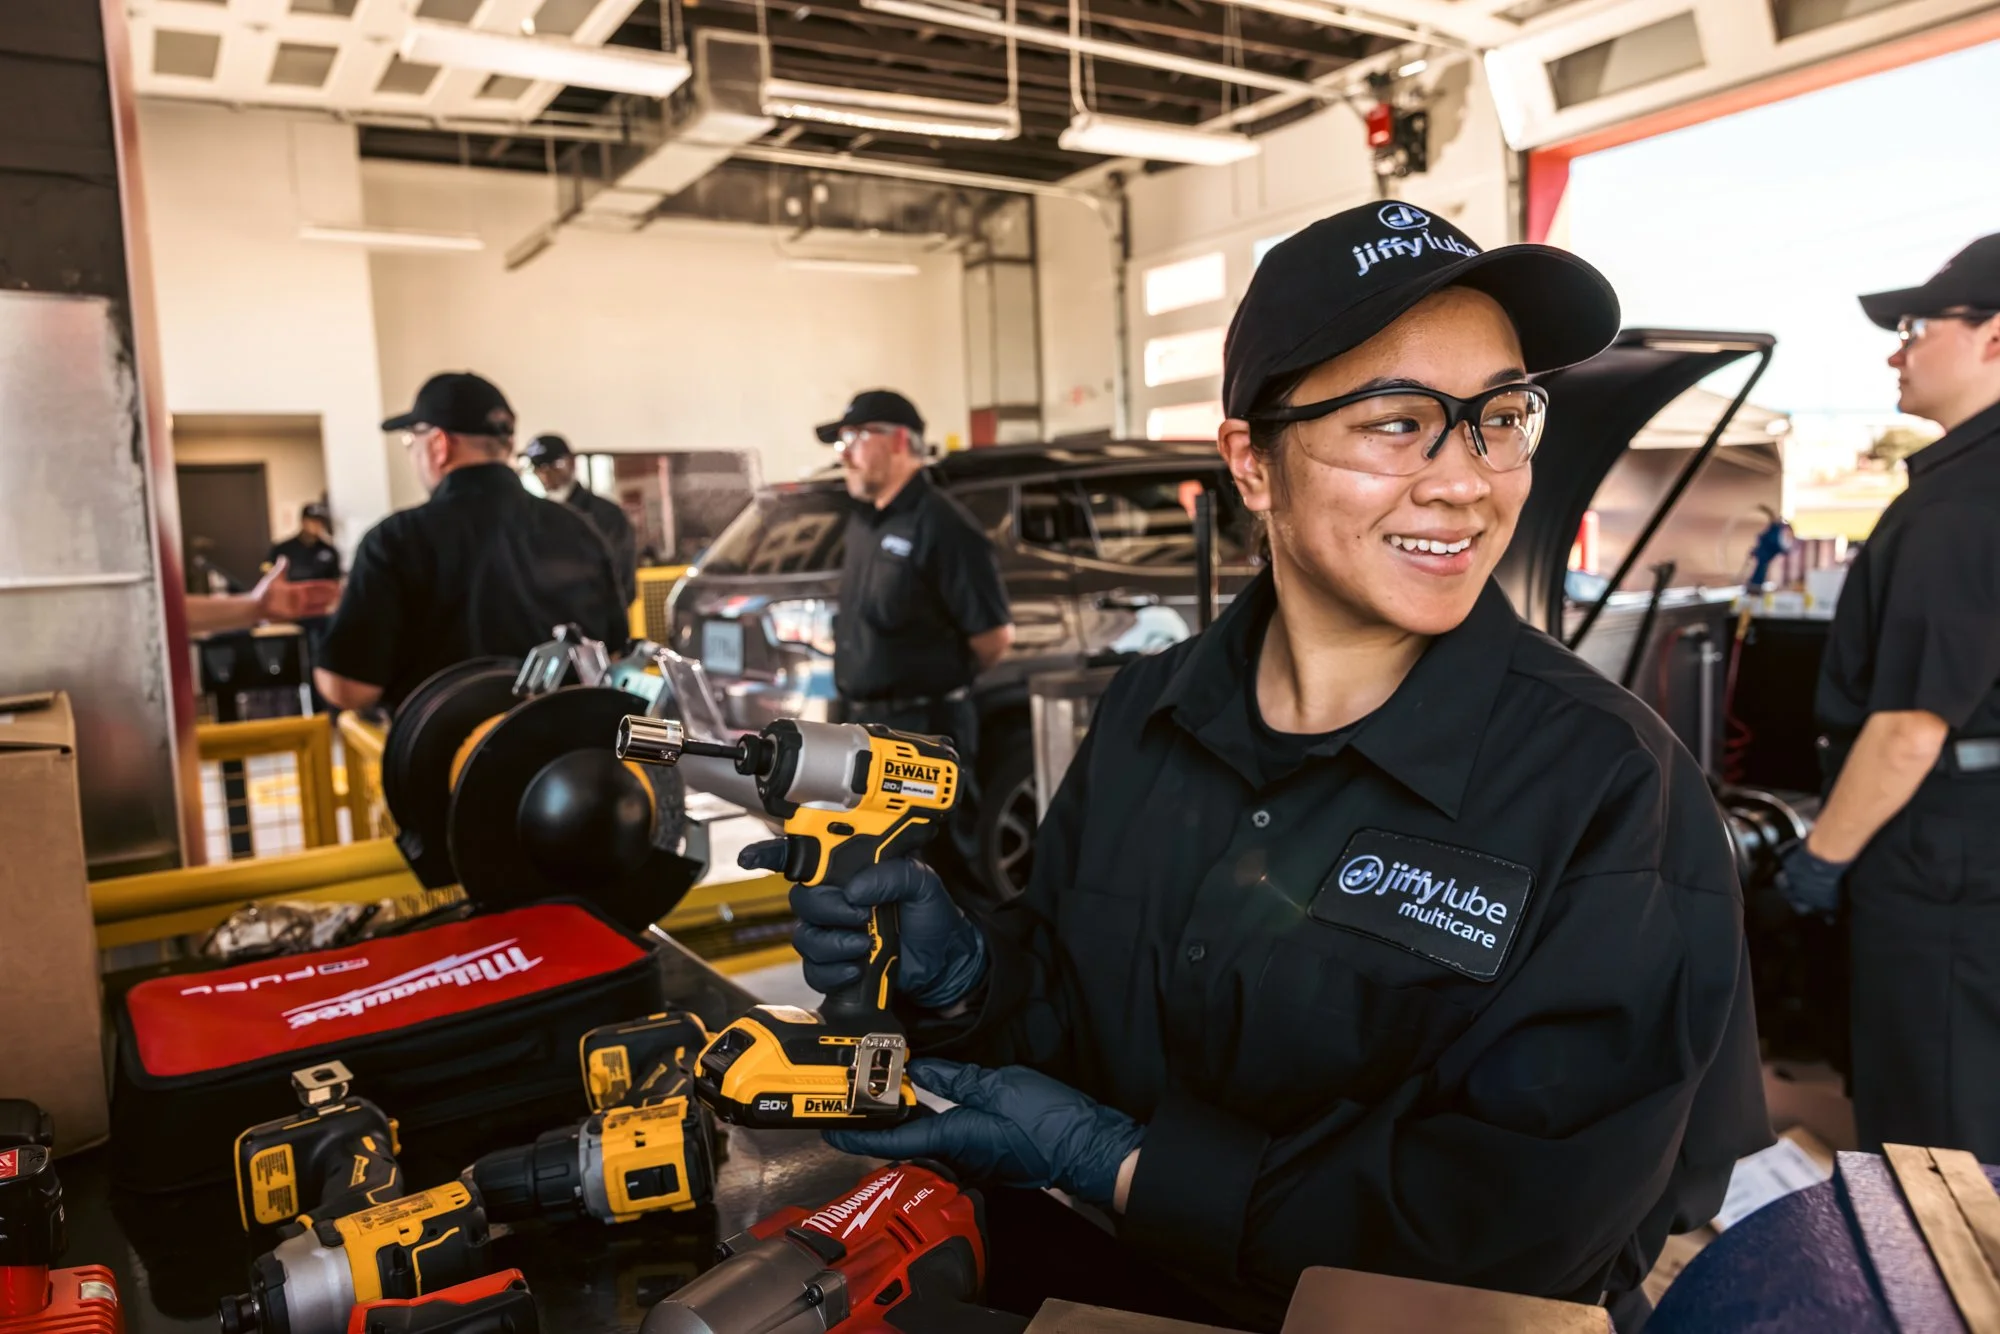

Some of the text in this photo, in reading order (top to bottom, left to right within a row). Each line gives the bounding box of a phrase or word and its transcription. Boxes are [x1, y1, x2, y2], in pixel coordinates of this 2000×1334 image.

[1352, 236, 1423, 277] jiffy
[884, 761, 941, 781] DEWALT
[1375, 861, 1508, 925] jiffy lube
[1398, 901, 1497, 949] multicare
[288, 946, 544, 1030] Milwaukee
[804, 1100, 847, 1112] DEWA
[801, 1170, 900, 1234] Milwaukee
[902, 1186, 936, 1215] FUEL
